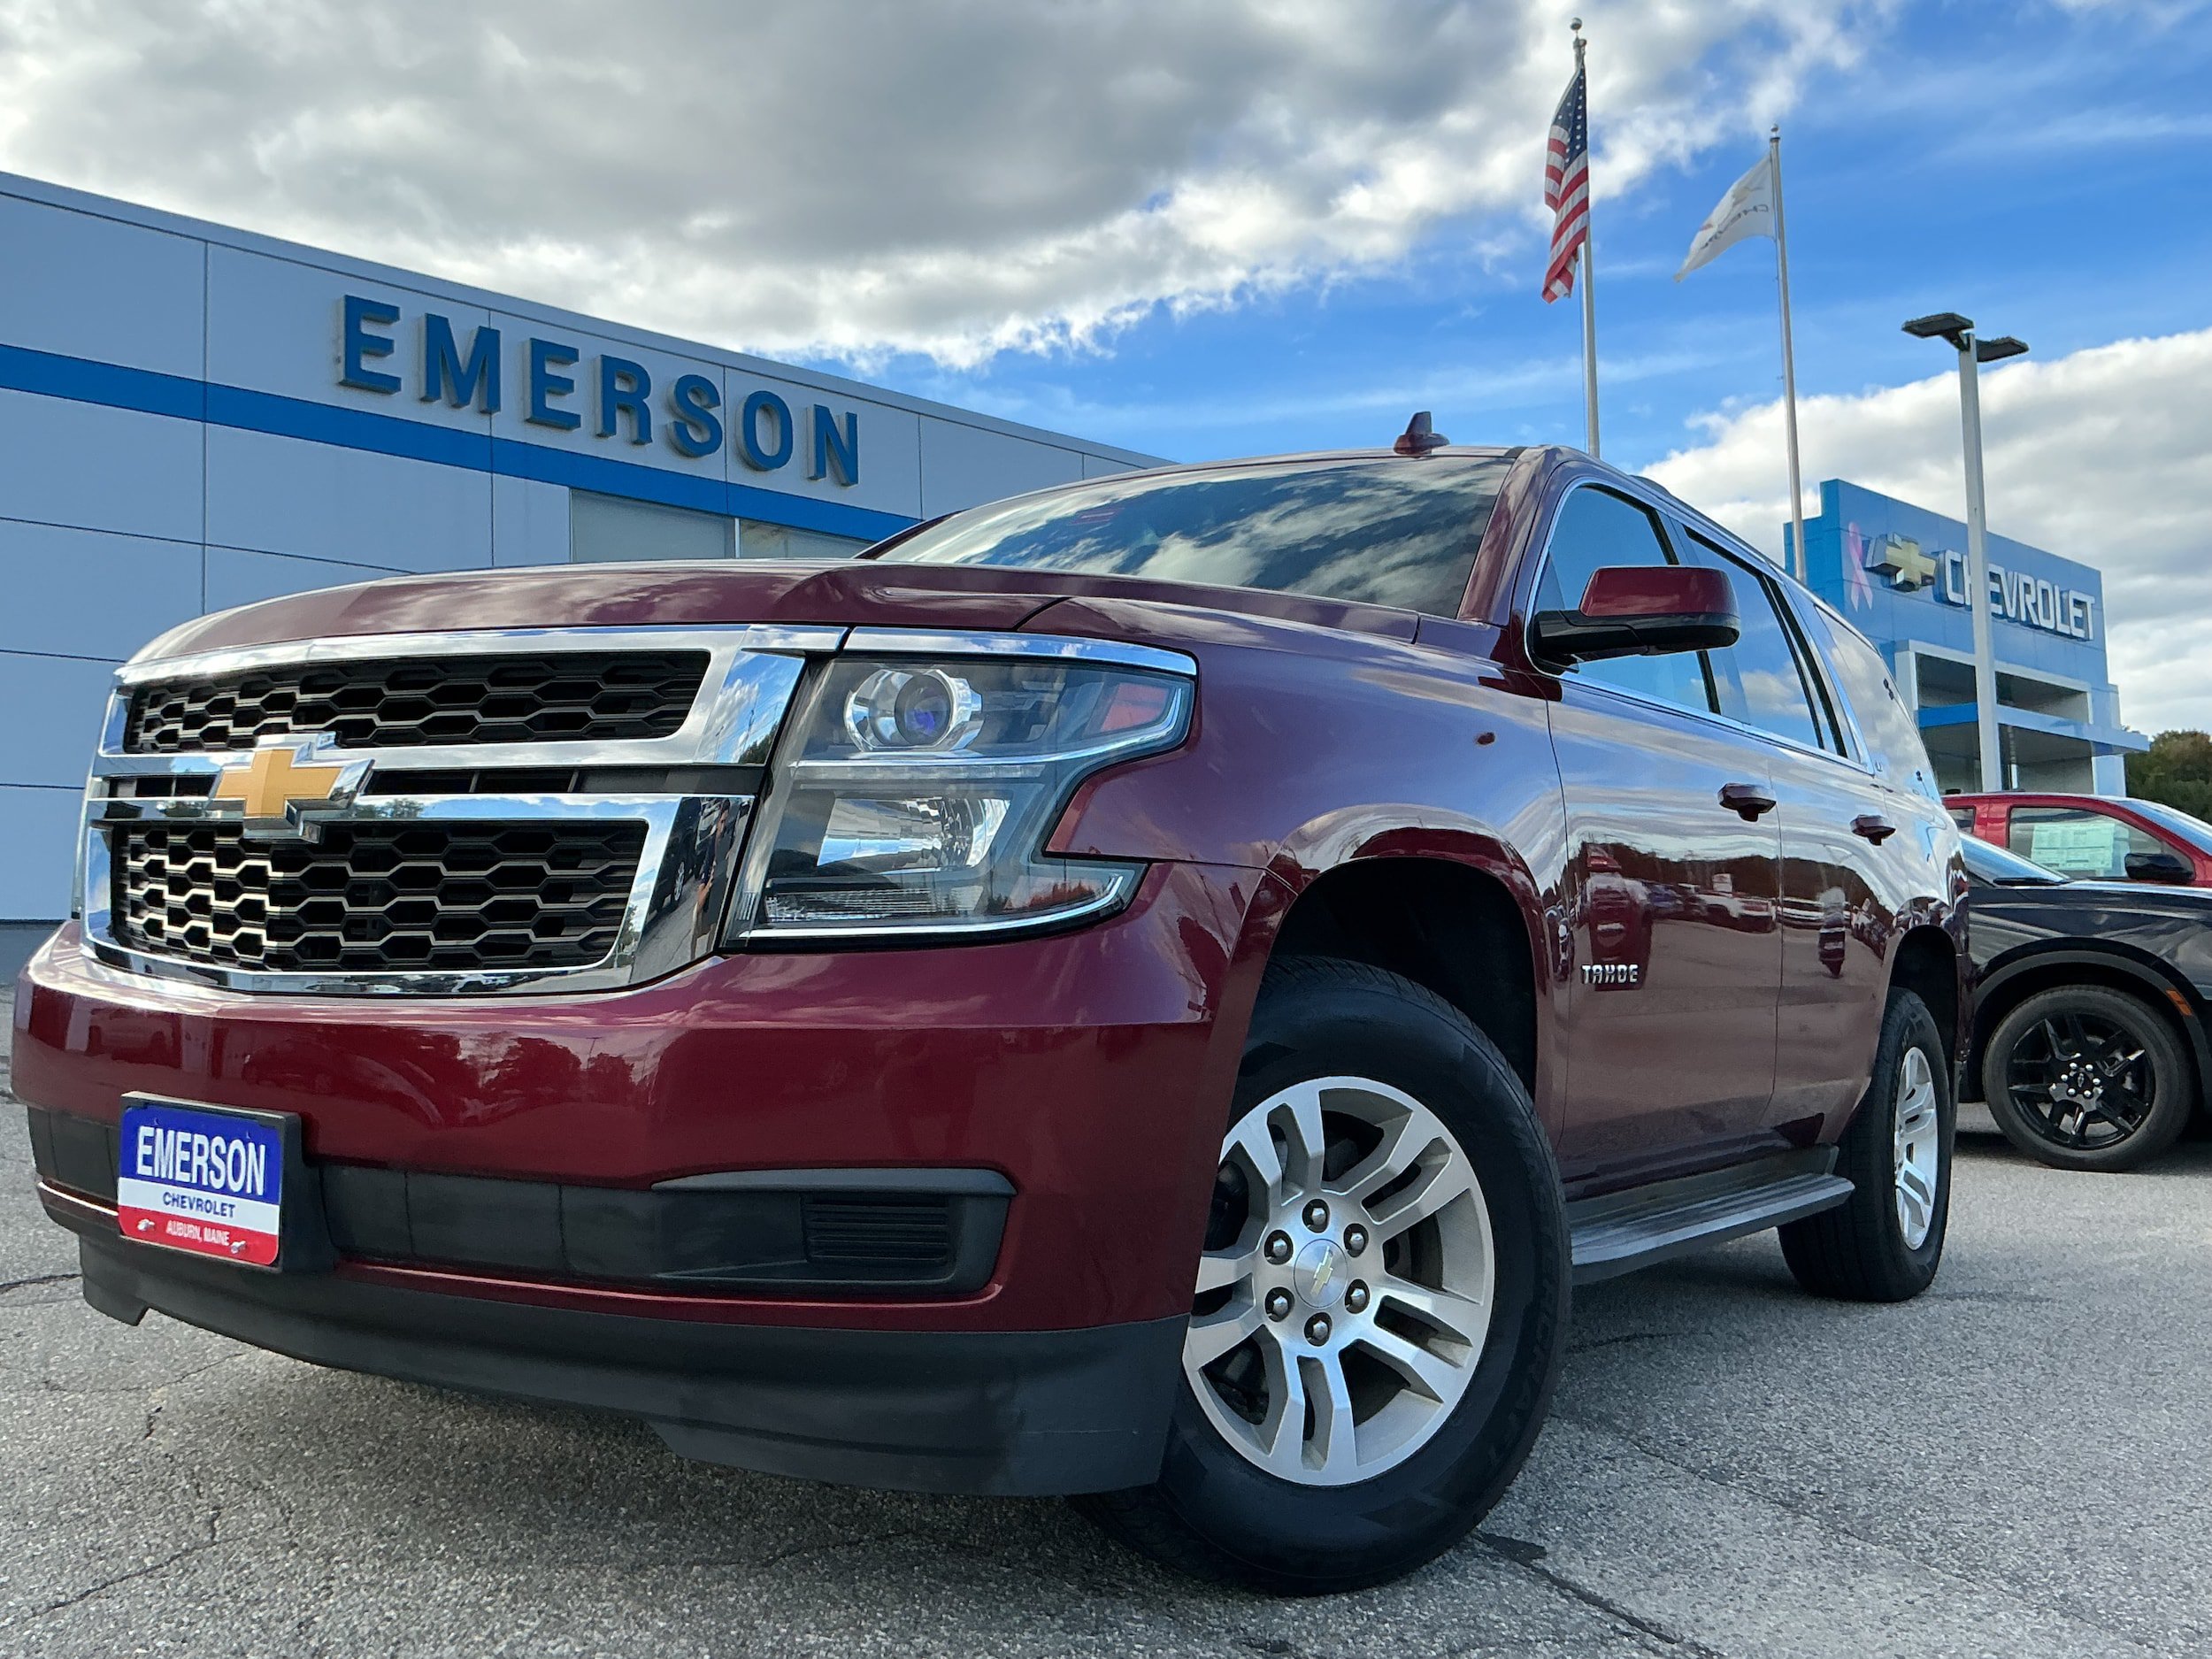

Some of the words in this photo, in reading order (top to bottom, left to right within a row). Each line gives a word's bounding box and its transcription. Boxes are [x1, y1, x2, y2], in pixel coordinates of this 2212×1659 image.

[341, 295, 859, 486] EMERSON
[1581, 964, 1639, 984] TAHOE
[136, 1125, 267, 1196] EMERSON
[163, 1192, 236, 1217] CHEVROLET
[204, 1227, 231, 1246] MAINE
